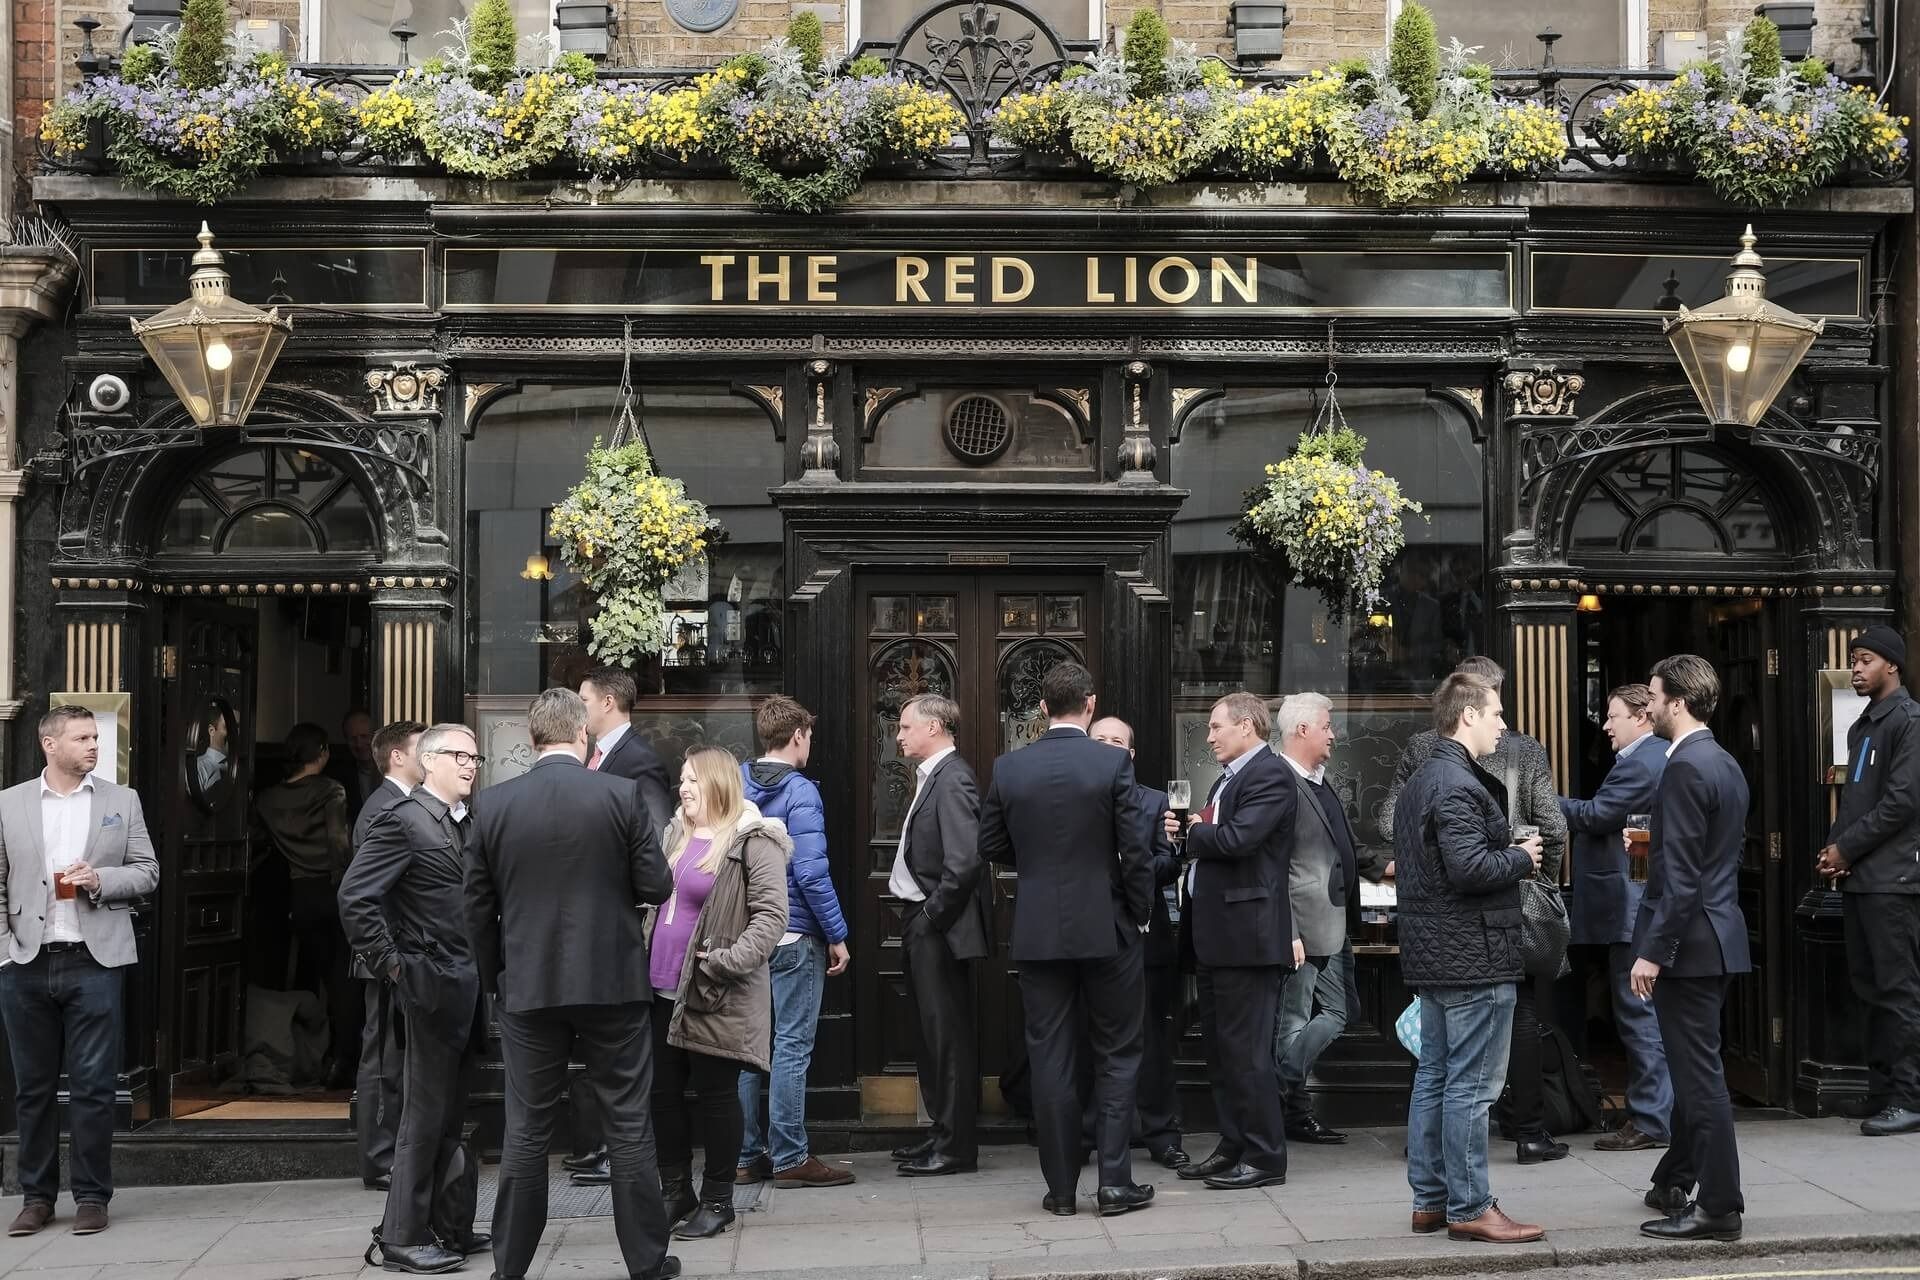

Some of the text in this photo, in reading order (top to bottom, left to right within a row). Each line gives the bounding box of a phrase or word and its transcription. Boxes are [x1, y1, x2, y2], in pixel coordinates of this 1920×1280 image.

[701, 255, 1258, 304] THE RED LION
